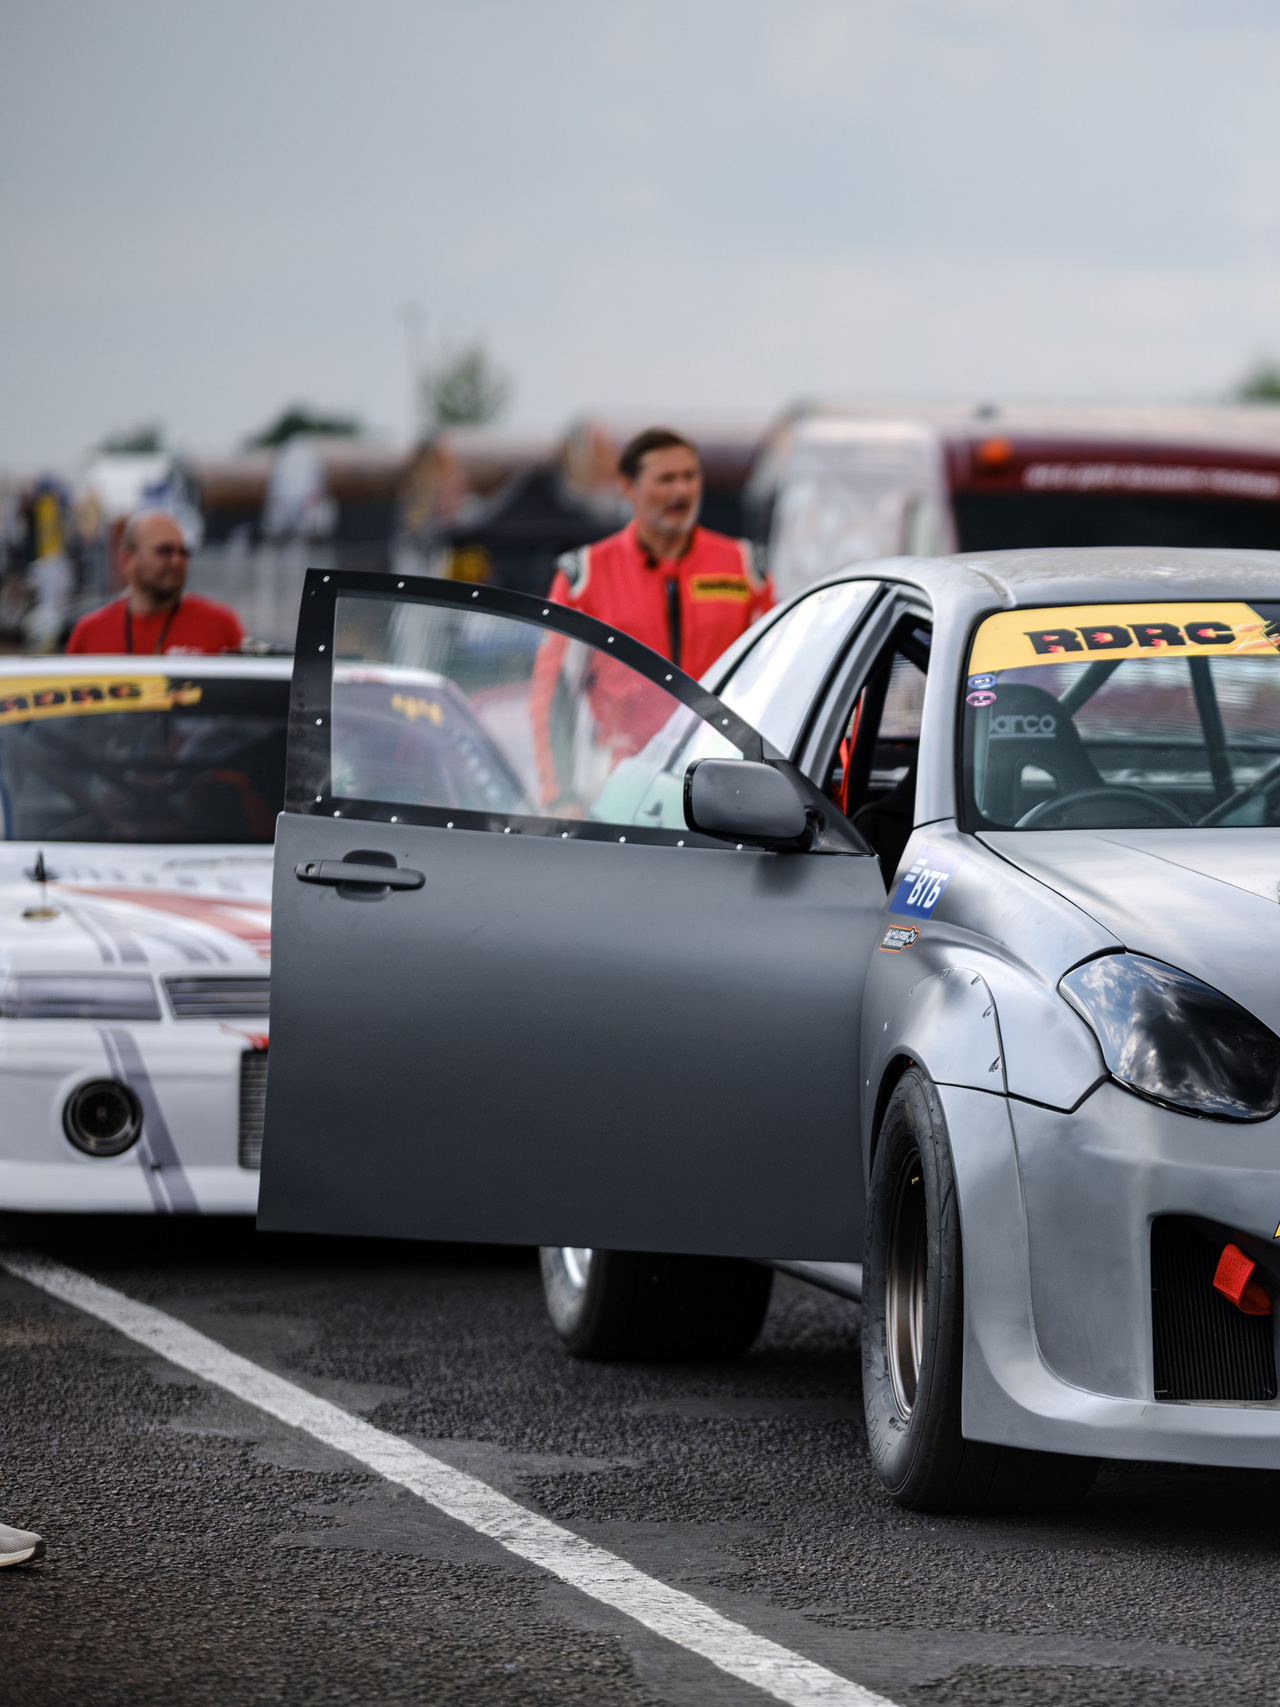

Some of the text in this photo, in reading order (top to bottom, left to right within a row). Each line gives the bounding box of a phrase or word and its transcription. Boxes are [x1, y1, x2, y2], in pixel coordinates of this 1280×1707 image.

[1023, 621, 1236, 655] RDRC
[989, 714, 1056, 733] arco
[906, 868, 950, 909] ВТБ
